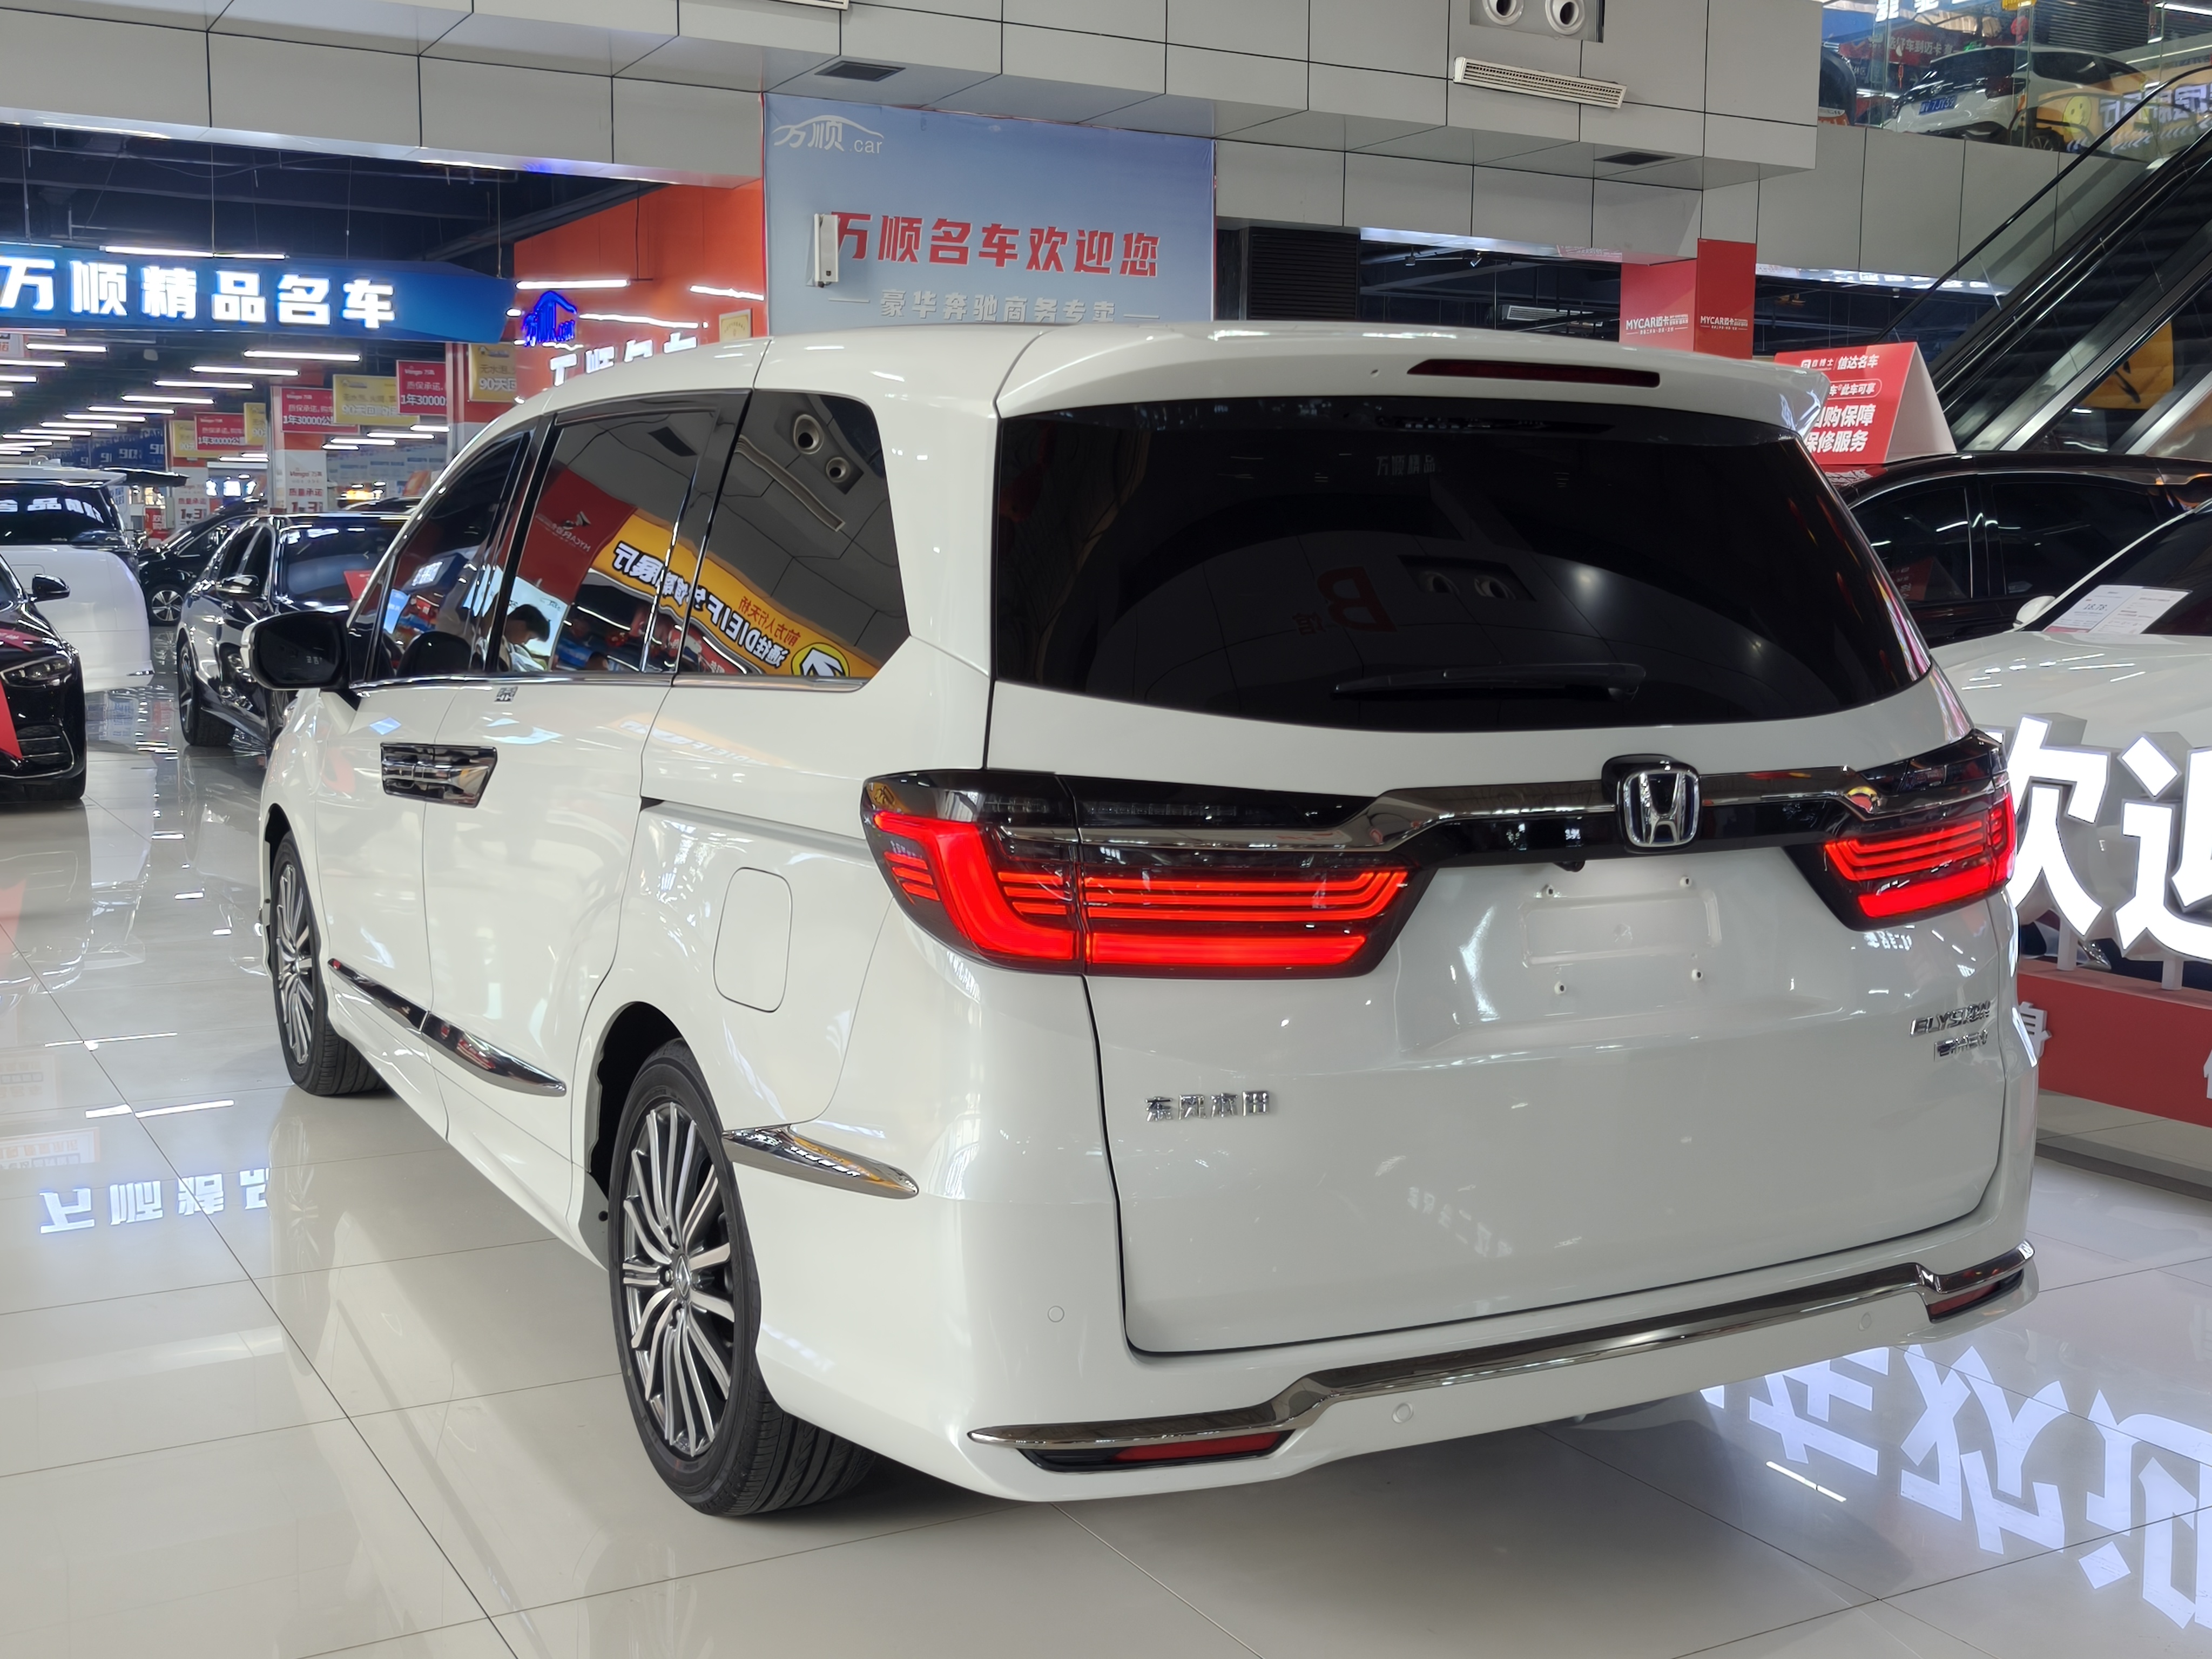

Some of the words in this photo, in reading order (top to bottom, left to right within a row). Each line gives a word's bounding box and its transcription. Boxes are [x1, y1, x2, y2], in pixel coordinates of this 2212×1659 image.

[773, 115, 845, 153] 万顺
[830, 211, 1159, 278] 万顺名车欢迎您
[0, 256, 395, 328] 万顺精品名车
[880, 289, 1116, 324] 豪华奔驰商务专卖
[1837, 354, 1879, 370] 信达名车
[1805, 430, 1869, 453] 保修服务
[1144, 1090, 1269, 1122] 东风本田
